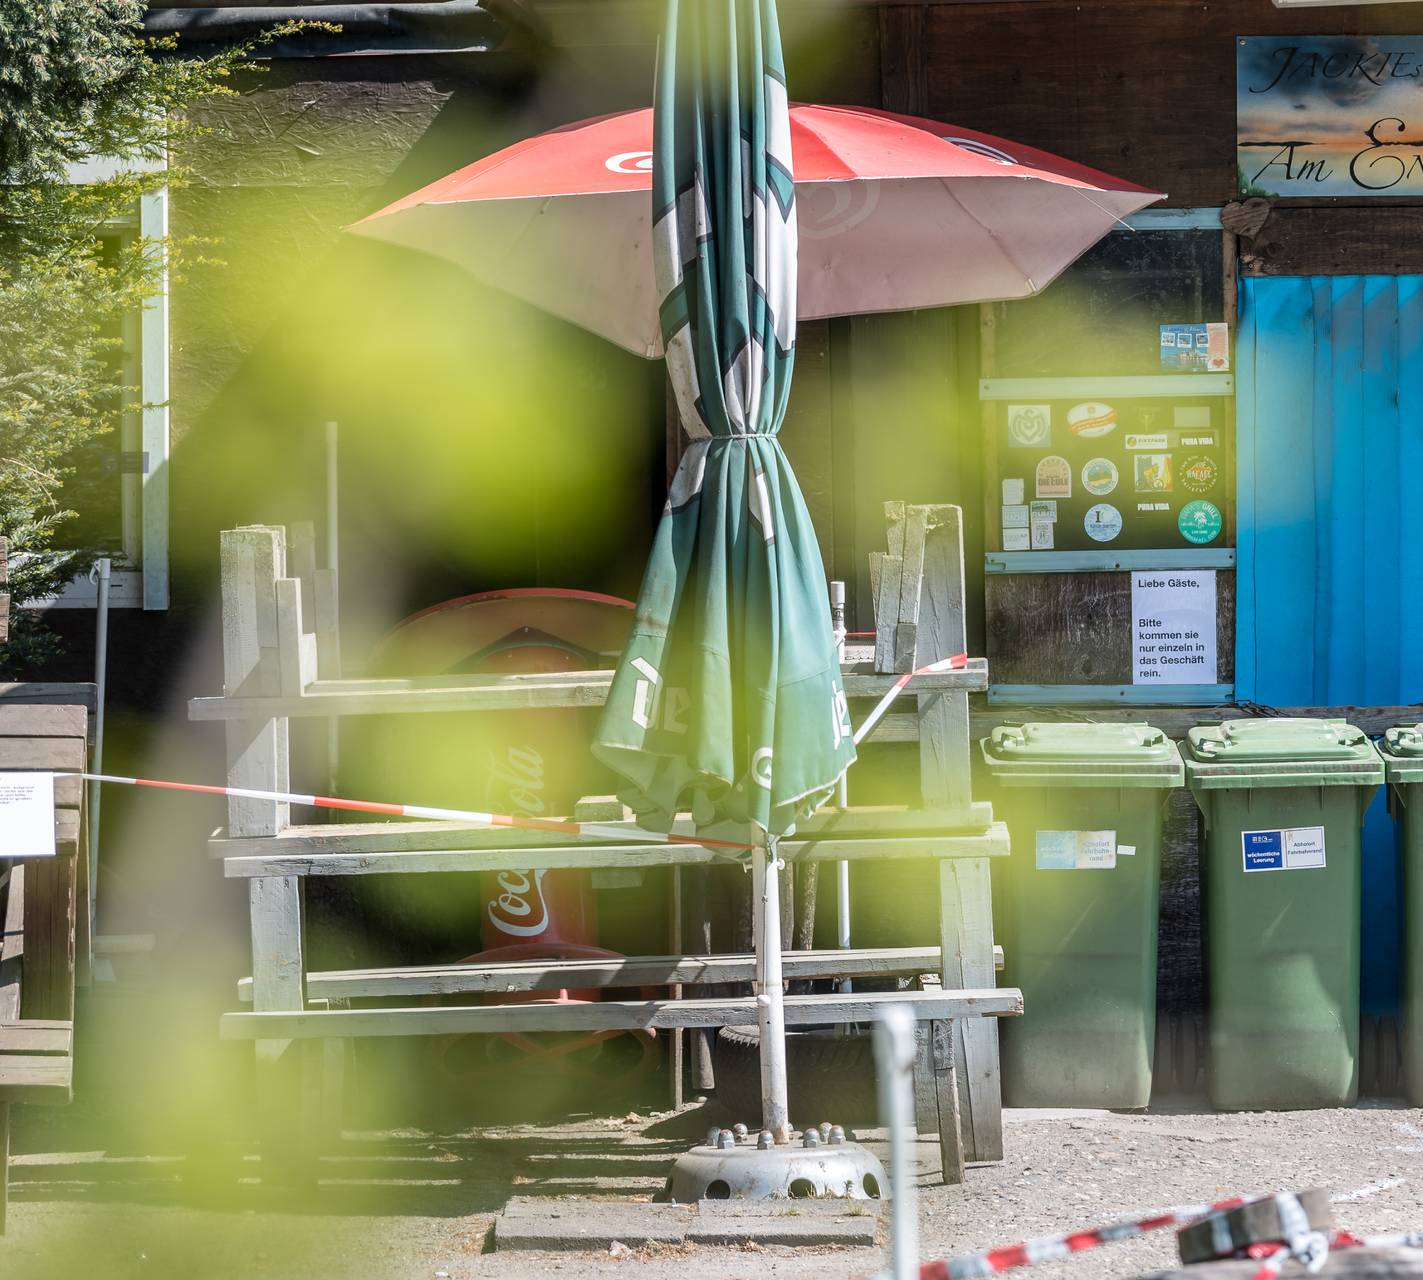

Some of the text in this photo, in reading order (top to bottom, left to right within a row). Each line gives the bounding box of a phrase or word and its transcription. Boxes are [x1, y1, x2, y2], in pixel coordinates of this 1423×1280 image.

[1251, 144, 1334, 187] Am
[1138, 578, 1200, 588] Liebe Gäste,
[1138, 618, 1162, 628] Bitte
[1139, 630, 1199, 640] kommen sie
[1139, 642, 1205, 652] nur einzeln in
[1139, 655, 1205, 665] das Geschäft
[1139, 669, 1161, 678] rein.
